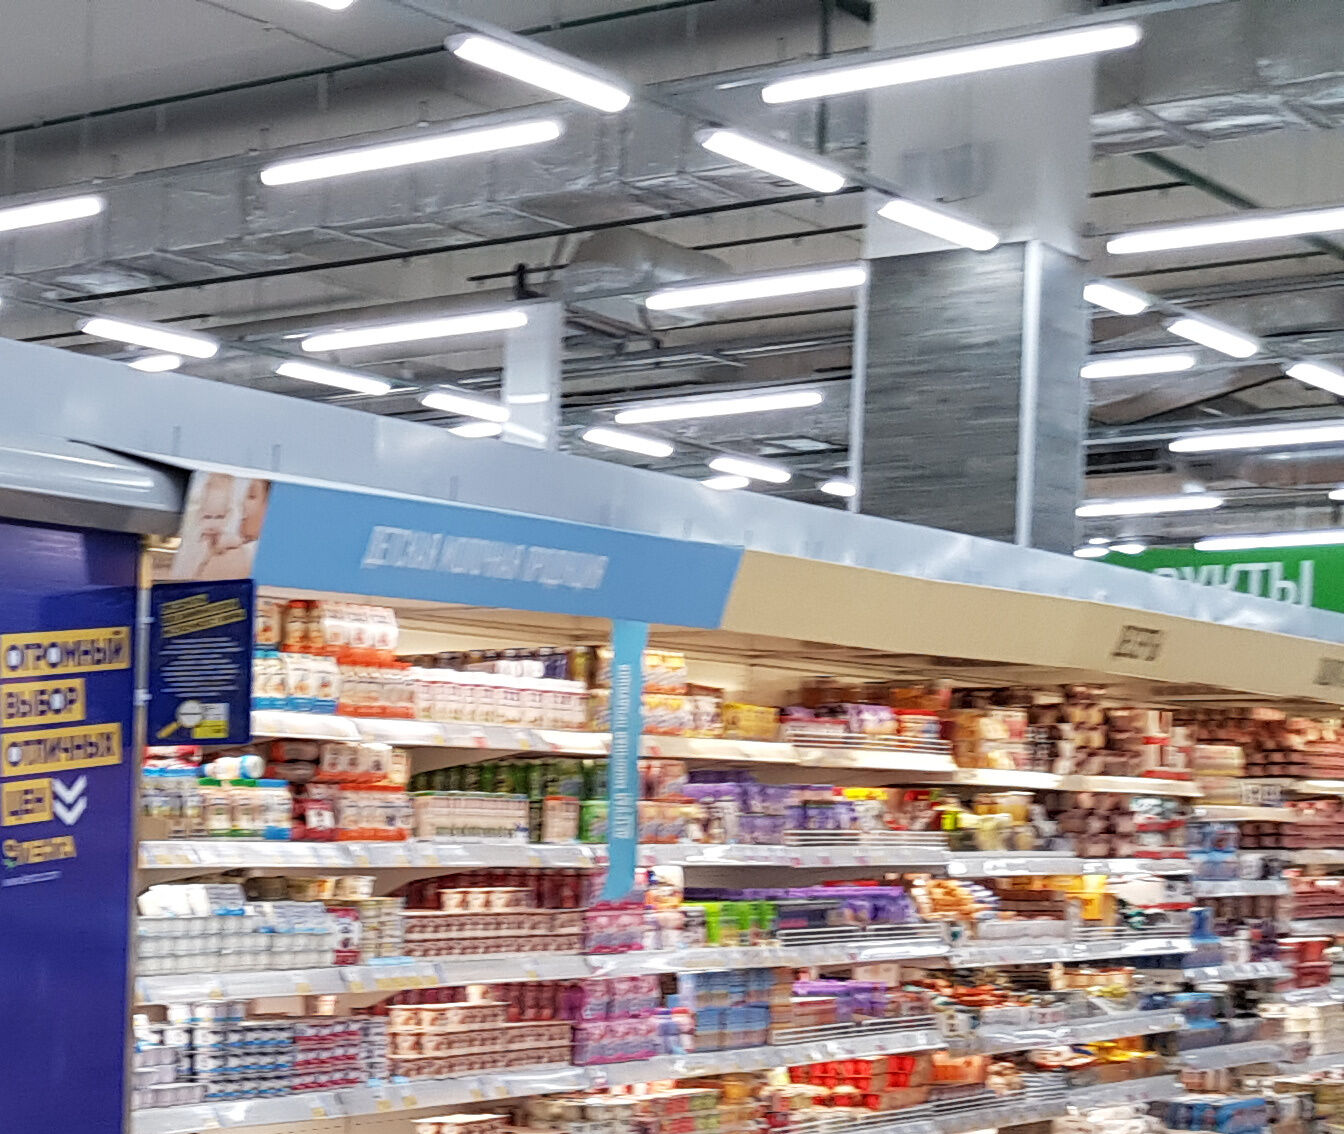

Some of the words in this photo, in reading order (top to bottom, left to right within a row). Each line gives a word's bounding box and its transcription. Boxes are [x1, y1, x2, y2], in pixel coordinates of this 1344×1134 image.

[6, 630, 125, 671] ОГРОМНЫЙ
[6, 687, 78, 719] ВЫБОР
[7, 732, 116, 767] ОТЛИЧНЫХ
[6, 787, 47, 820] ЦЕН
